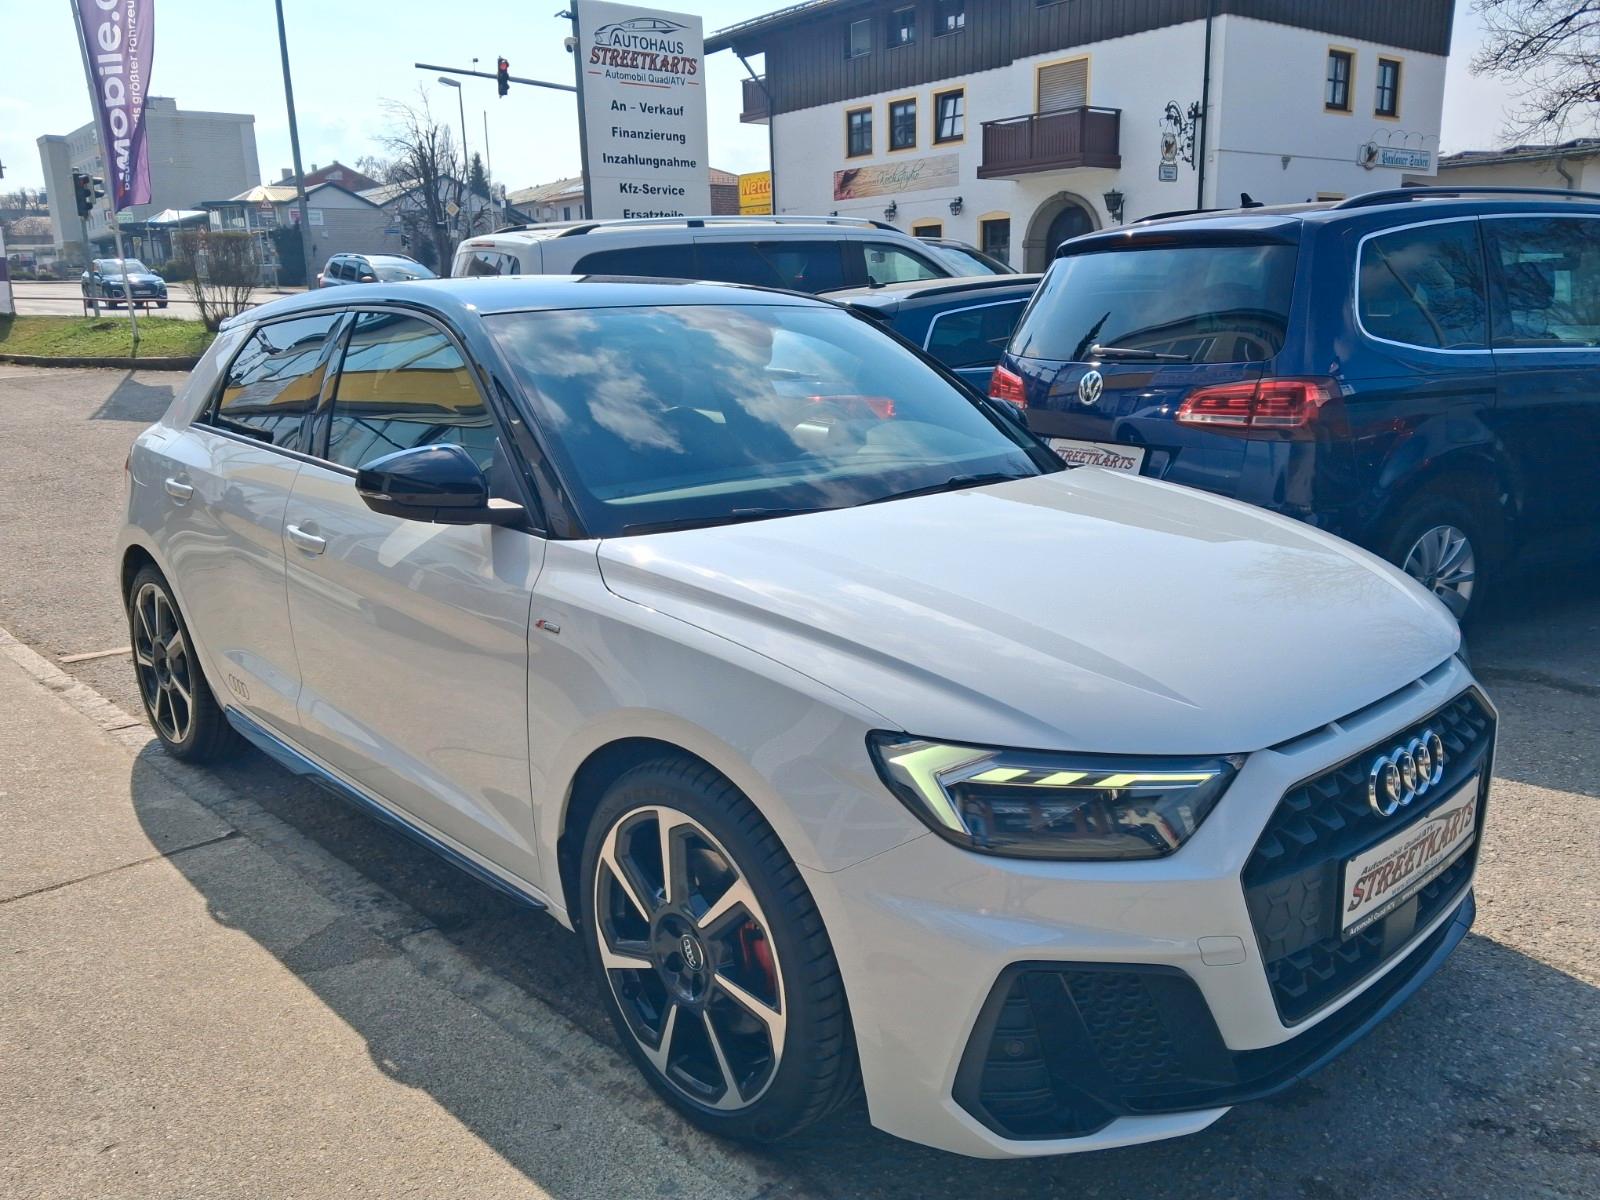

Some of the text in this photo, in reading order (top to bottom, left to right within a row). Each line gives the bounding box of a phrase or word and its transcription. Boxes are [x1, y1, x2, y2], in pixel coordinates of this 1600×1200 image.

[613, 33, 684, 54] AUTOHAUS
[589, 46, 697, 75] STREETKARTS
[129, 56, 142, 104] größter
[605, 69, 646, 81] Automobil
[611, 100, 626, 111] An
[640, 102, 684, 116] Verkauf
[611, 126, 686, 145] Finanzierung
[602, 152, 697, 168] Inzahlungnahme
[619, 182, 685, 196] Kfz-Service
[1056, 448, 1136, 470] TREETKARTS
[1347, 796, 1476, 912] STREETKARTS
